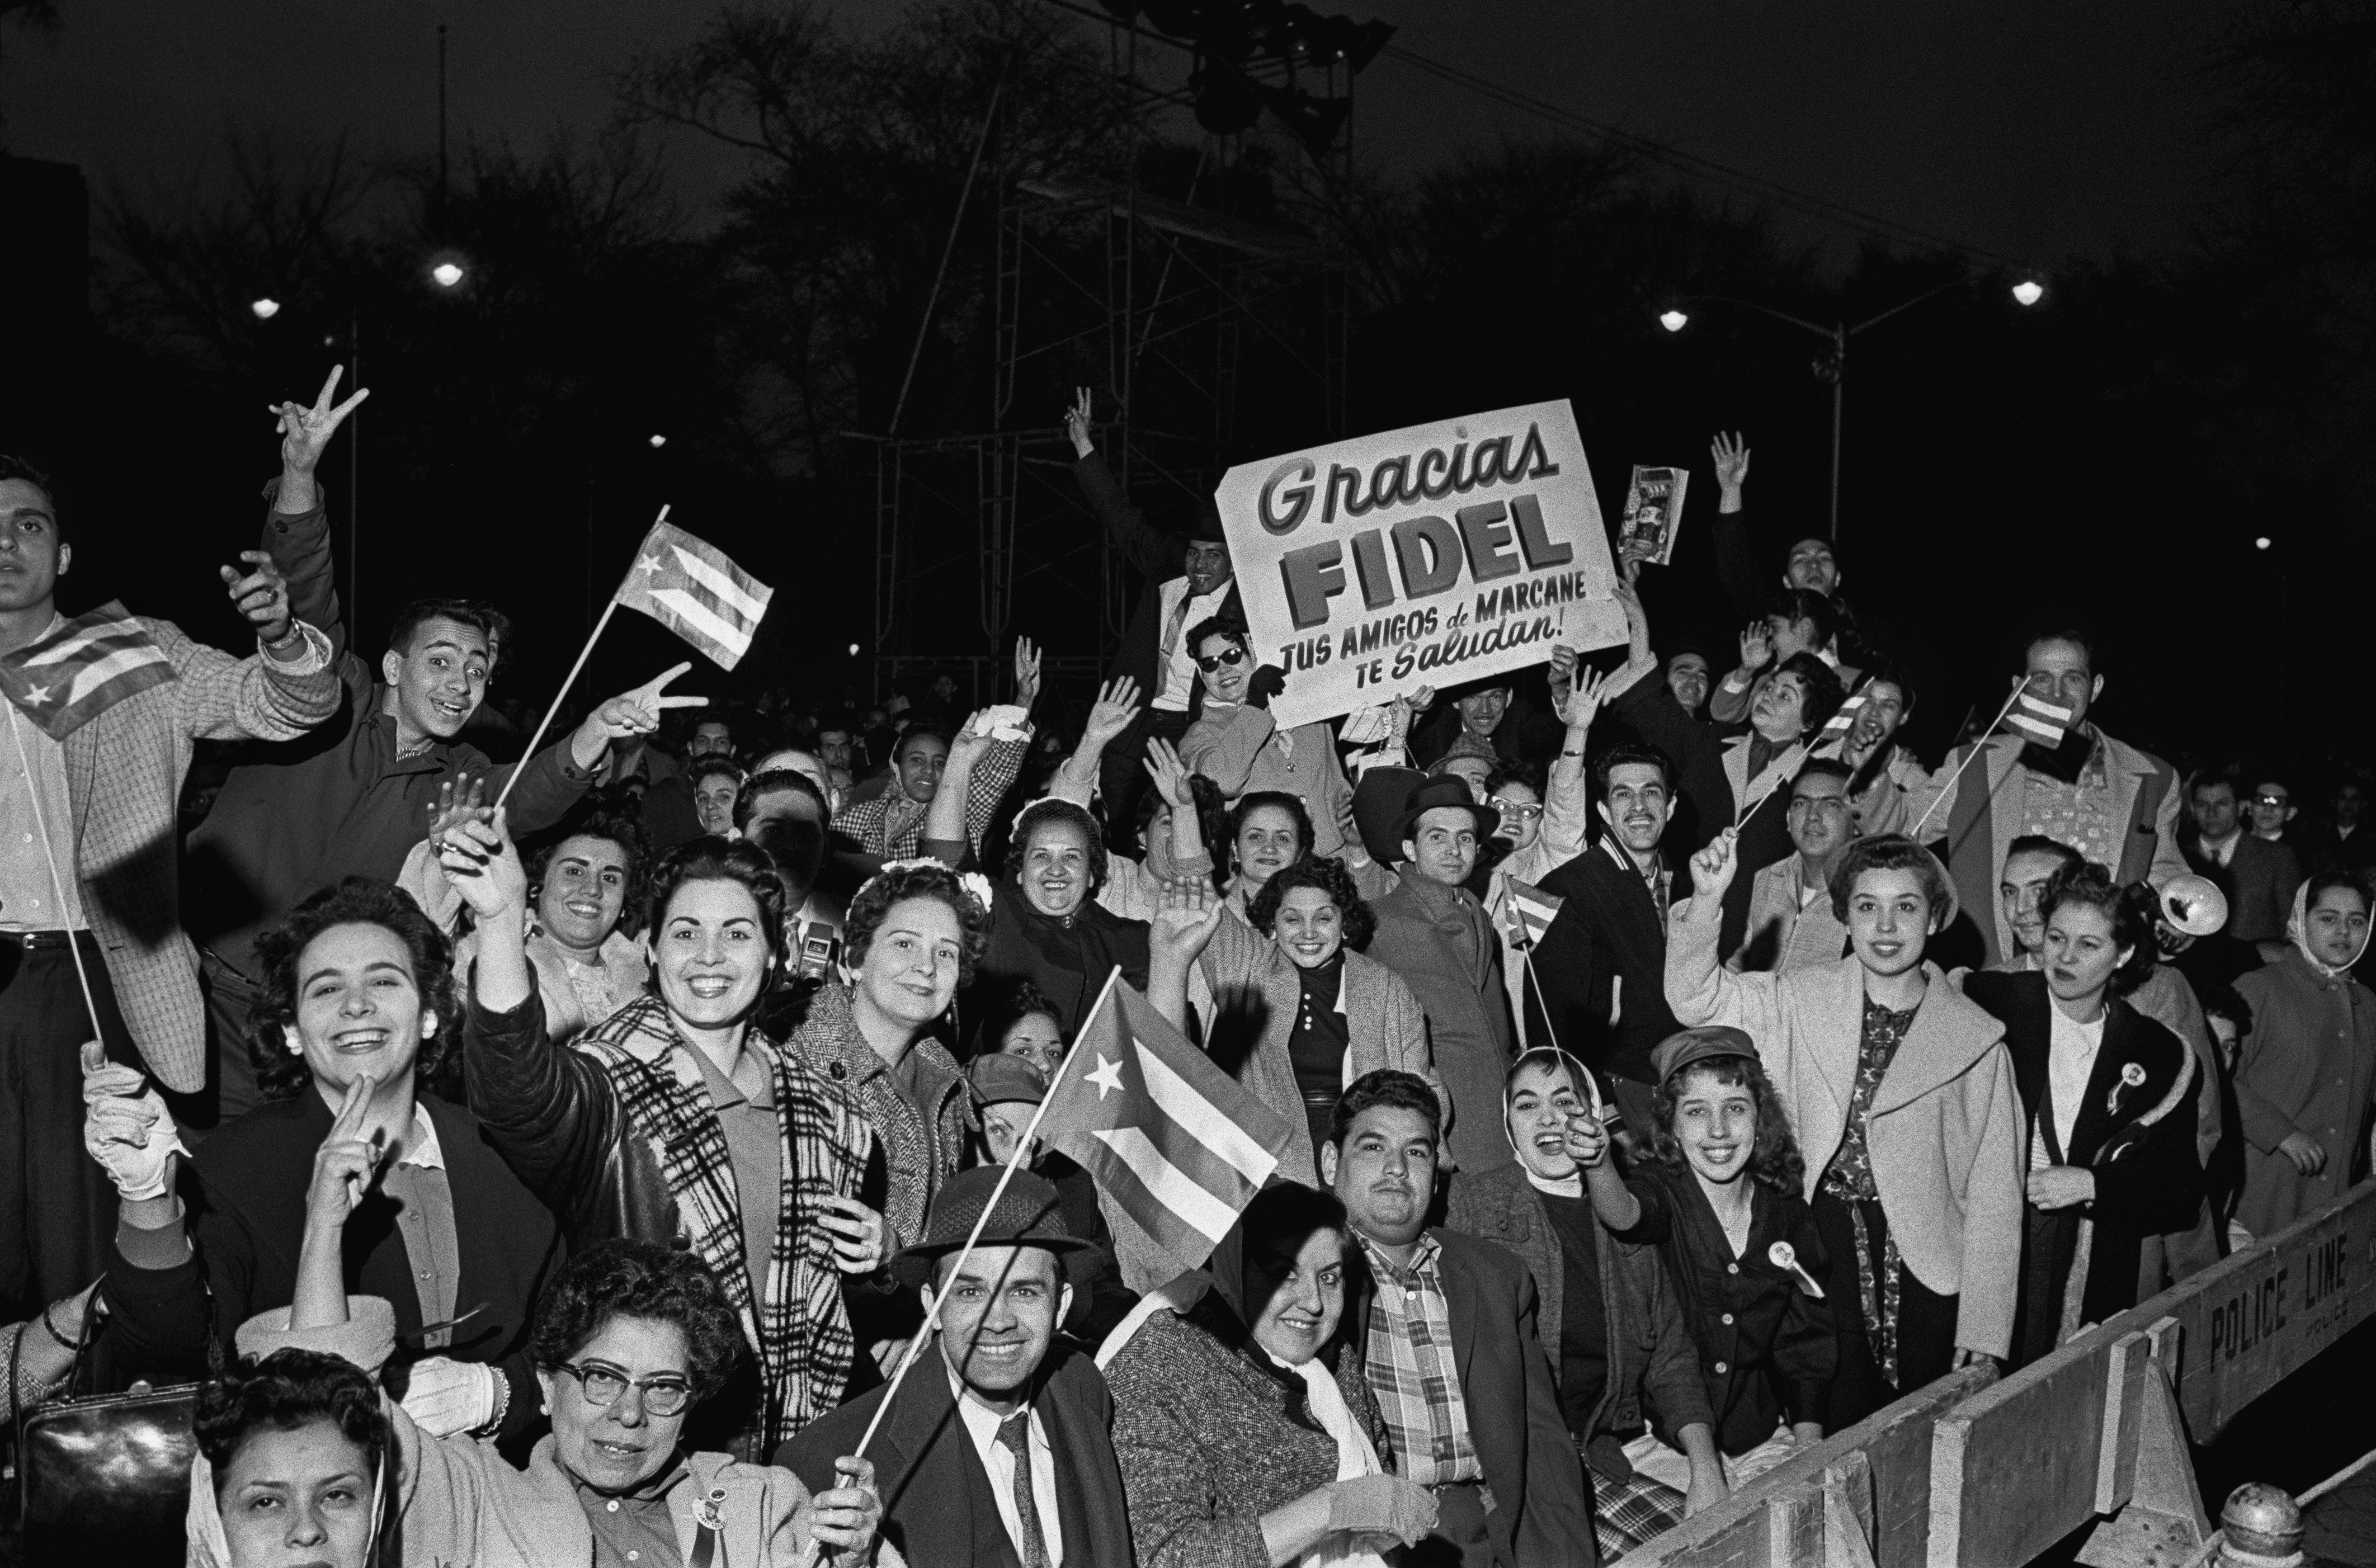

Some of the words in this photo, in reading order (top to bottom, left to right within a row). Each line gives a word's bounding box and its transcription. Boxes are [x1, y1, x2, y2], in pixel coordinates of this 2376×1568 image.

[1258, 421, 1559, 536] Gracias
[1279, 494, 1573, 631] FIDEL
[1280, 634, 1332, 674] TUS
[1340, 606, 1438, 659] AMIGOS
[1446, 602, 1469, 629] de
[1475, 570, 1586, 622] MARCANE
[1355, 658, 1383, 688] TE
[1391, 606, 1564, 680] Saludan!
[2210, 1267, 2288, 1373] POLICE
[2305, 1232, 2346, 1310] LINE
